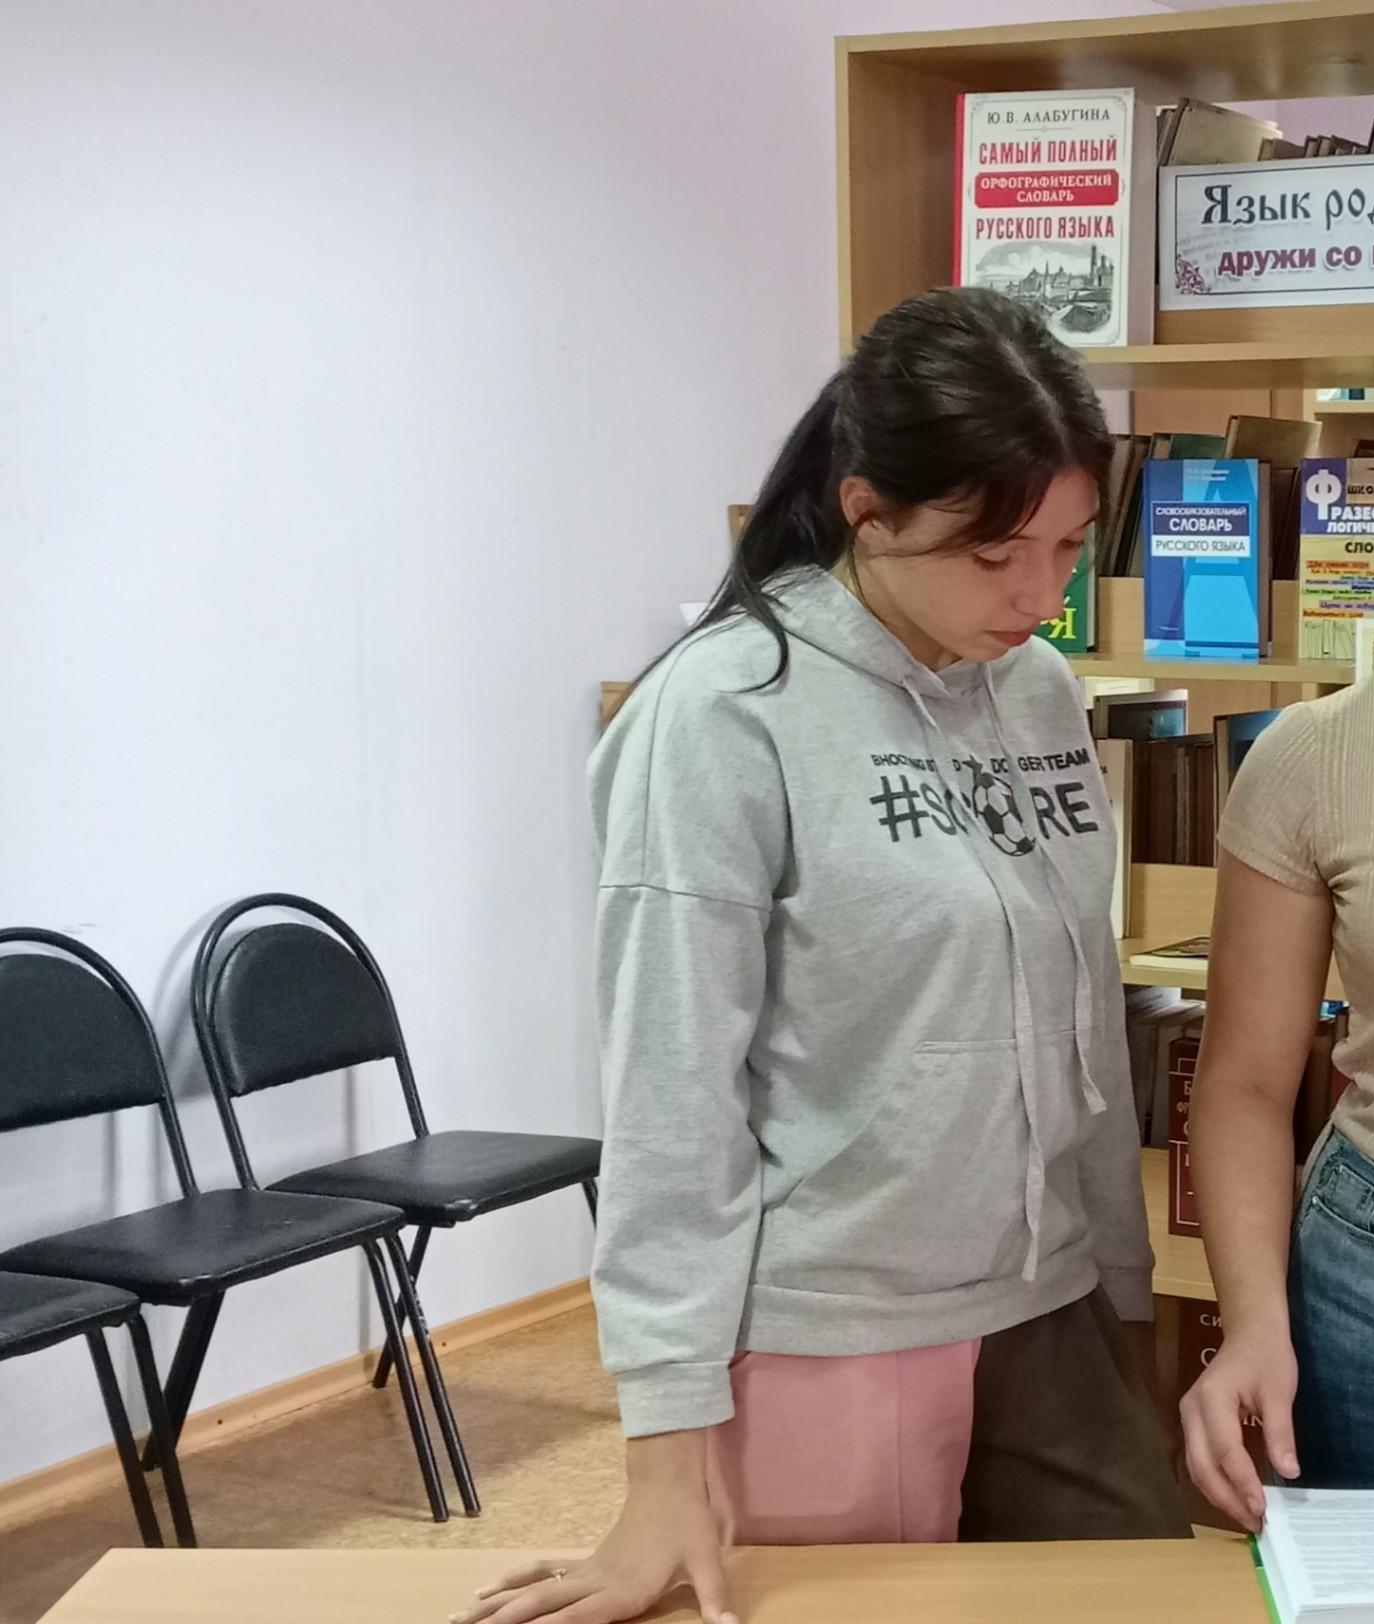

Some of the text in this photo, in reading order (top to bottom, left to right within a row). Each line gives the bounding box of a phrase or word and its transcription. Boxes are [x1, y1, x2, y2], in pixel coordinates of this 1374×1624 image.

[1024, 109, 1110, 123] АЛАБУГИНА
[979, 135, 1117, 164] САМЫЙ ПОЛНЫЙ
[981, 174, 1112, 189] ОРФОГРАФИЧЕСКИЙ
[1017, 190, 1074, 202] СЛОВАРЬ
[1201, 185, 1311, 224] Язык
[976, 216, 1114, 239] РУССКОГО ЯЗЫКА
[1218, 249, 1316, 276] дружи
[1326, 246, 1362, 267] со
[1169, 518, 1232, 531] СЛОВАРЬ
[1156, 540, 1245, 551] РУССКОГО ЯЗЫКА
[1043, 747, 1090, 771] TEAM
